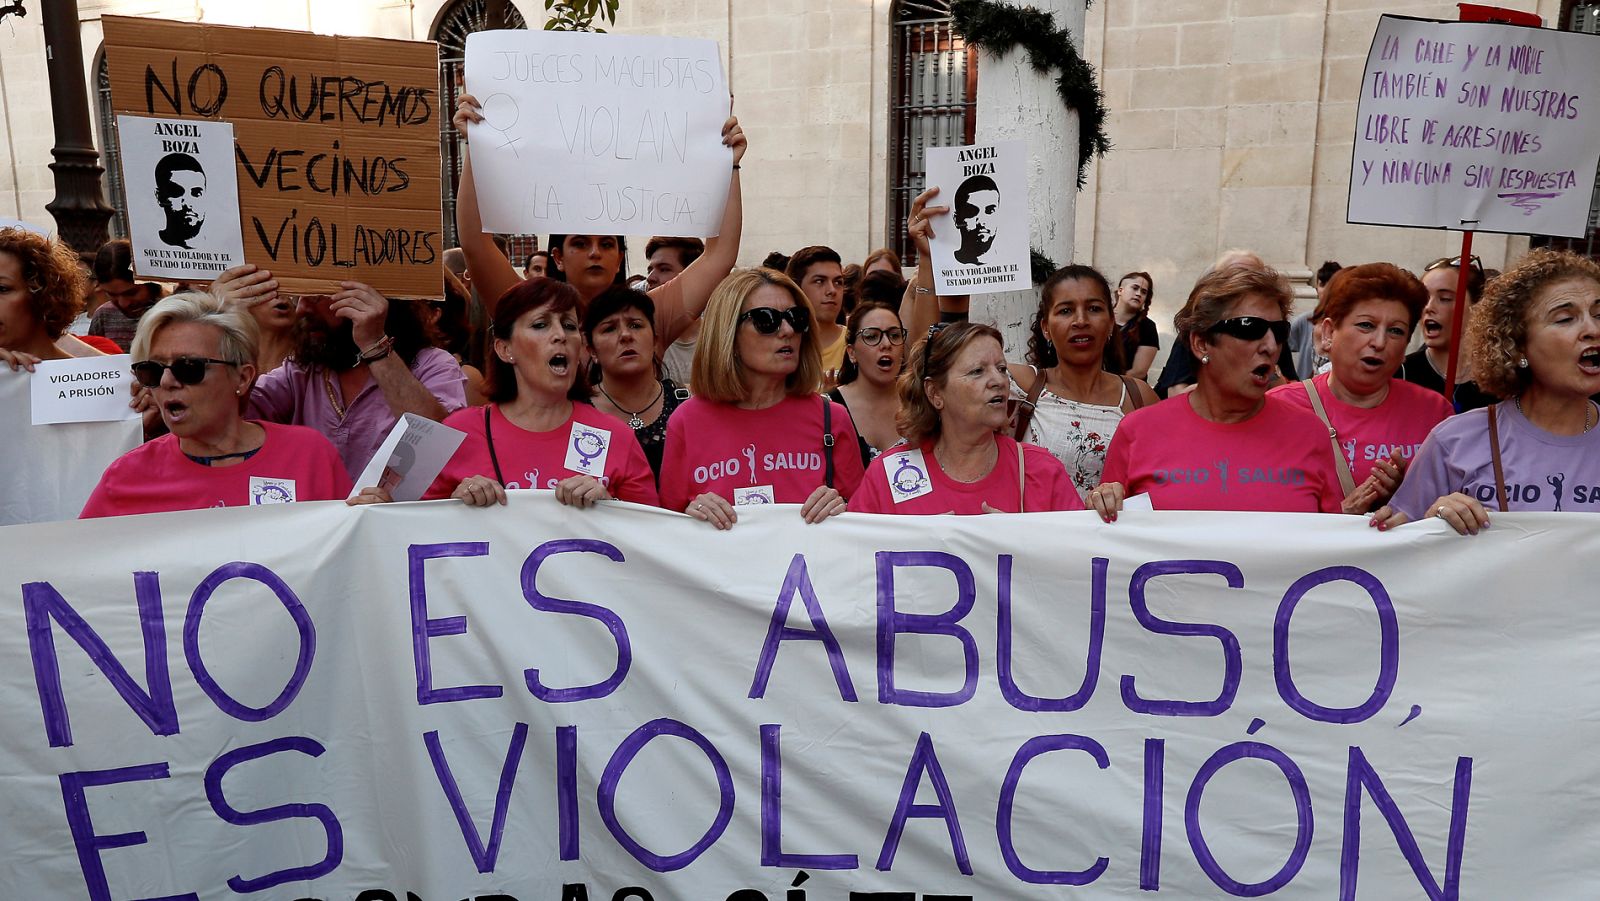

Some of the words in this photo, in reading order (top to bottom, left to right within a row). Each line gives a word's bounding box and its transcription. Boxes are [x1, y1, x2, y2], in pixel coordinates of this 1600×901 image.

[1381, 35, 1399, 62] LA
[1415, 38, 1456, 64] CALLE
[1462, 45, 1480, 72] Y
[1485, 45, 1501, 67] LA
[1507, 44, 1545, 75] NOCHE
[493, 51, 583, 84] JUECES
[595, 54, 715, 94] MACHISTAS
[144, 56, 228, 118] NO
[260, 66, 432, 127] QUEREMOS
[1372, 72, 1448, 99] TAMBIÉN
[1457, 82, 1491, 108] SON
[1500, 87, 1579, 120] NUESTRAS
[154, 122, 201, 138] ANGEL
[556, 103, 689, 165] VIOLAN
[1365, 114, 1410, 144] LIBRE
[1422, 119, 1439, 143] DE
[1442, 124, 1542, 155] AGRESIONES
[162, 140, 200, 154] BOZA
[957, 146, 998, 163] ANGEL
[236, 140, 410, 197] VECINOS
[963, 162, 996, 177] BOZA
[1362, 160, 1374, 185] Y
[1382, 158, 1451, 185] NINGUNA
[1464, 164, 1494, 189] SIN
[1499, 168, 1576, 190] RESPUESTA
[532, 183, 563, 222] LA
[585, 183, 696, 224] JUSTICIA
[253, 209, 437, 268] VIOLADORES
[143, 248, 158, 258] SOY
[160, 251, 171, 259] UN
[173, 251, 212, 261] VIOLADOR
[214, 254, 219, 262] Y
[221, 254, 231, 262] EL
[150, 259, 178, 269] ESTADO
[180, 261, 191, 269] LO
[941, 269, 954, 277] SOY
[955, 268, 965, 277] UN
[966, 266, 1002, 277] VIOLADOR
[1003, 265, 1009, 273] Y
[1010, 264, 1019, 272] EL
[946, 278, 972, 287] ESTADO
[973, 277, 982, 285] LO
[983, 274, 1016, 284] PERMITE
[50, 370, 121, 384] VIOLADORES
[58, 390, 66, 399] A
[69, 385, 114, 398] PRISIÓN
[693, 460, 740, 484] OCIO
[763, 453, 822, 473] SALUD
[1153, 468, 1210, 485] OCIO
[1238, 467, 1305, 486] SALUD
[21, 561, 317, 748] NO
[408, 538, 633, 706] ES
[748, 550, 1423, 729] ABUSO,
[58, 736, 344, 901] ES
[424, 717, 1473, 901] VIOLACIÓN
